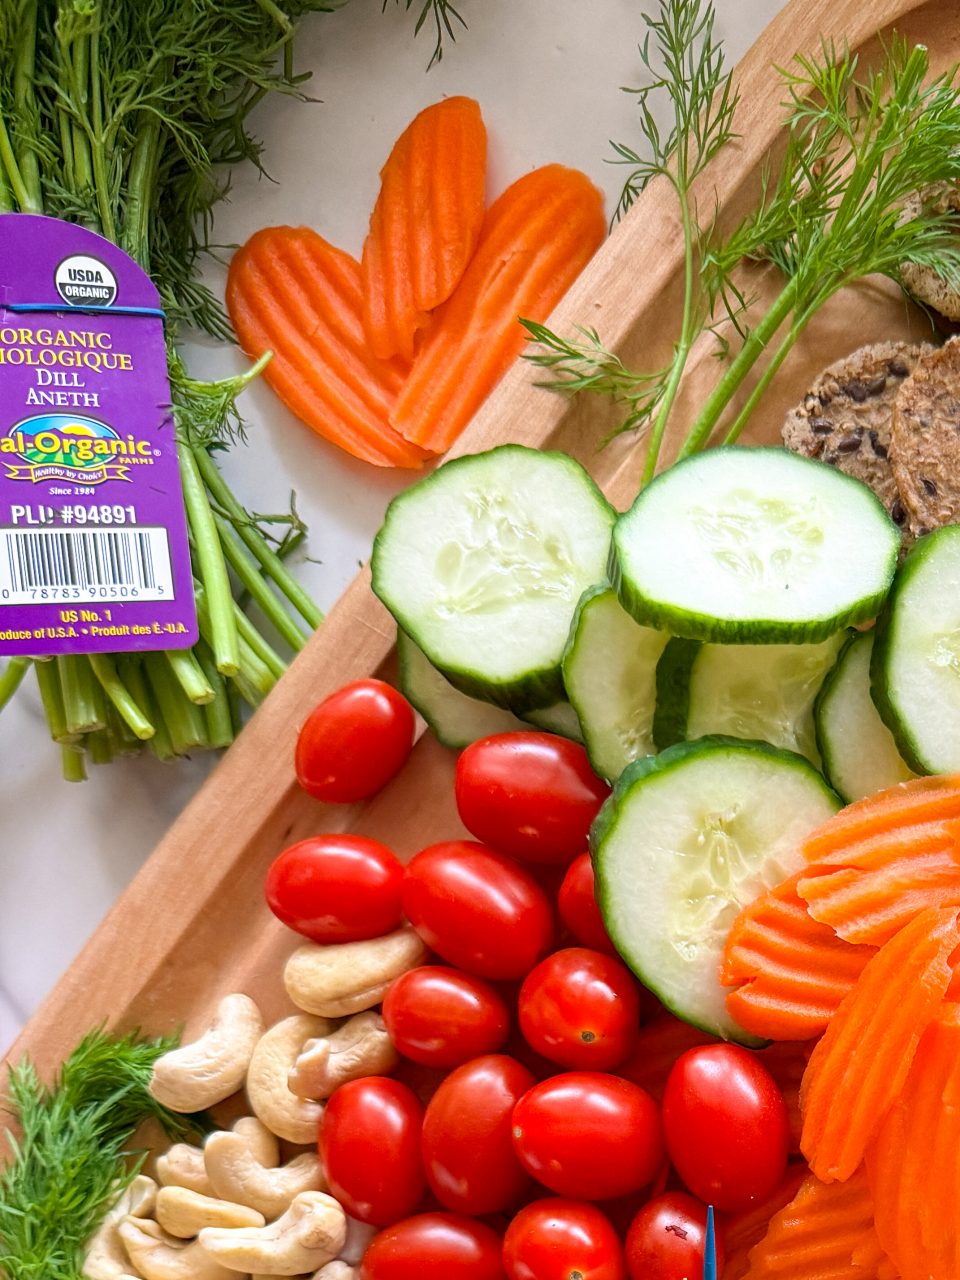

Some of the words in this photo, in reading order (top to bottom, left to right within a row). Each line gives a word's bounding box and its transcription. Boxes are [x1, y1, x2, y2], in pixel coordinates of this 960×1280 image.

[68, 268, 104, 284] USDA
[65, 285, 110, 299] ORGANIC
[0, 328, 113, 350] ORGANIC
[0, 347, 134, 373] IOLOGIQUE
[36, 368, 85, 388] DILL
[25, 387, 100, 408] ANETH
[119, 457, 154, 465] FARMS
[34, 467, 65, 478] Healthy
[66, 470, 76, 479] by
[78, 470, 103, 481] Choice
[48, 487, 72, 496] Since
[74, 487, 95, 496] 1984
[10, 504, 54, 525] PLU
[61, 505, 137, 525] #94891
[30, 588, 81, 600] 78783
[89, 586, 139, 598] 90506
[158, 585, 165, 595] 5
[60, 610, 78, 623] US
[81, 610, 102, 622] No.
[105, 609, 112, 621] 1
[0, 629, 31, 640] oduce
[34, 628, 45, 639] of
[47, 626, 79, 639] U.S.A.
[91, 624, 129, 637] Produit
[133, 624, 151, 635] des
